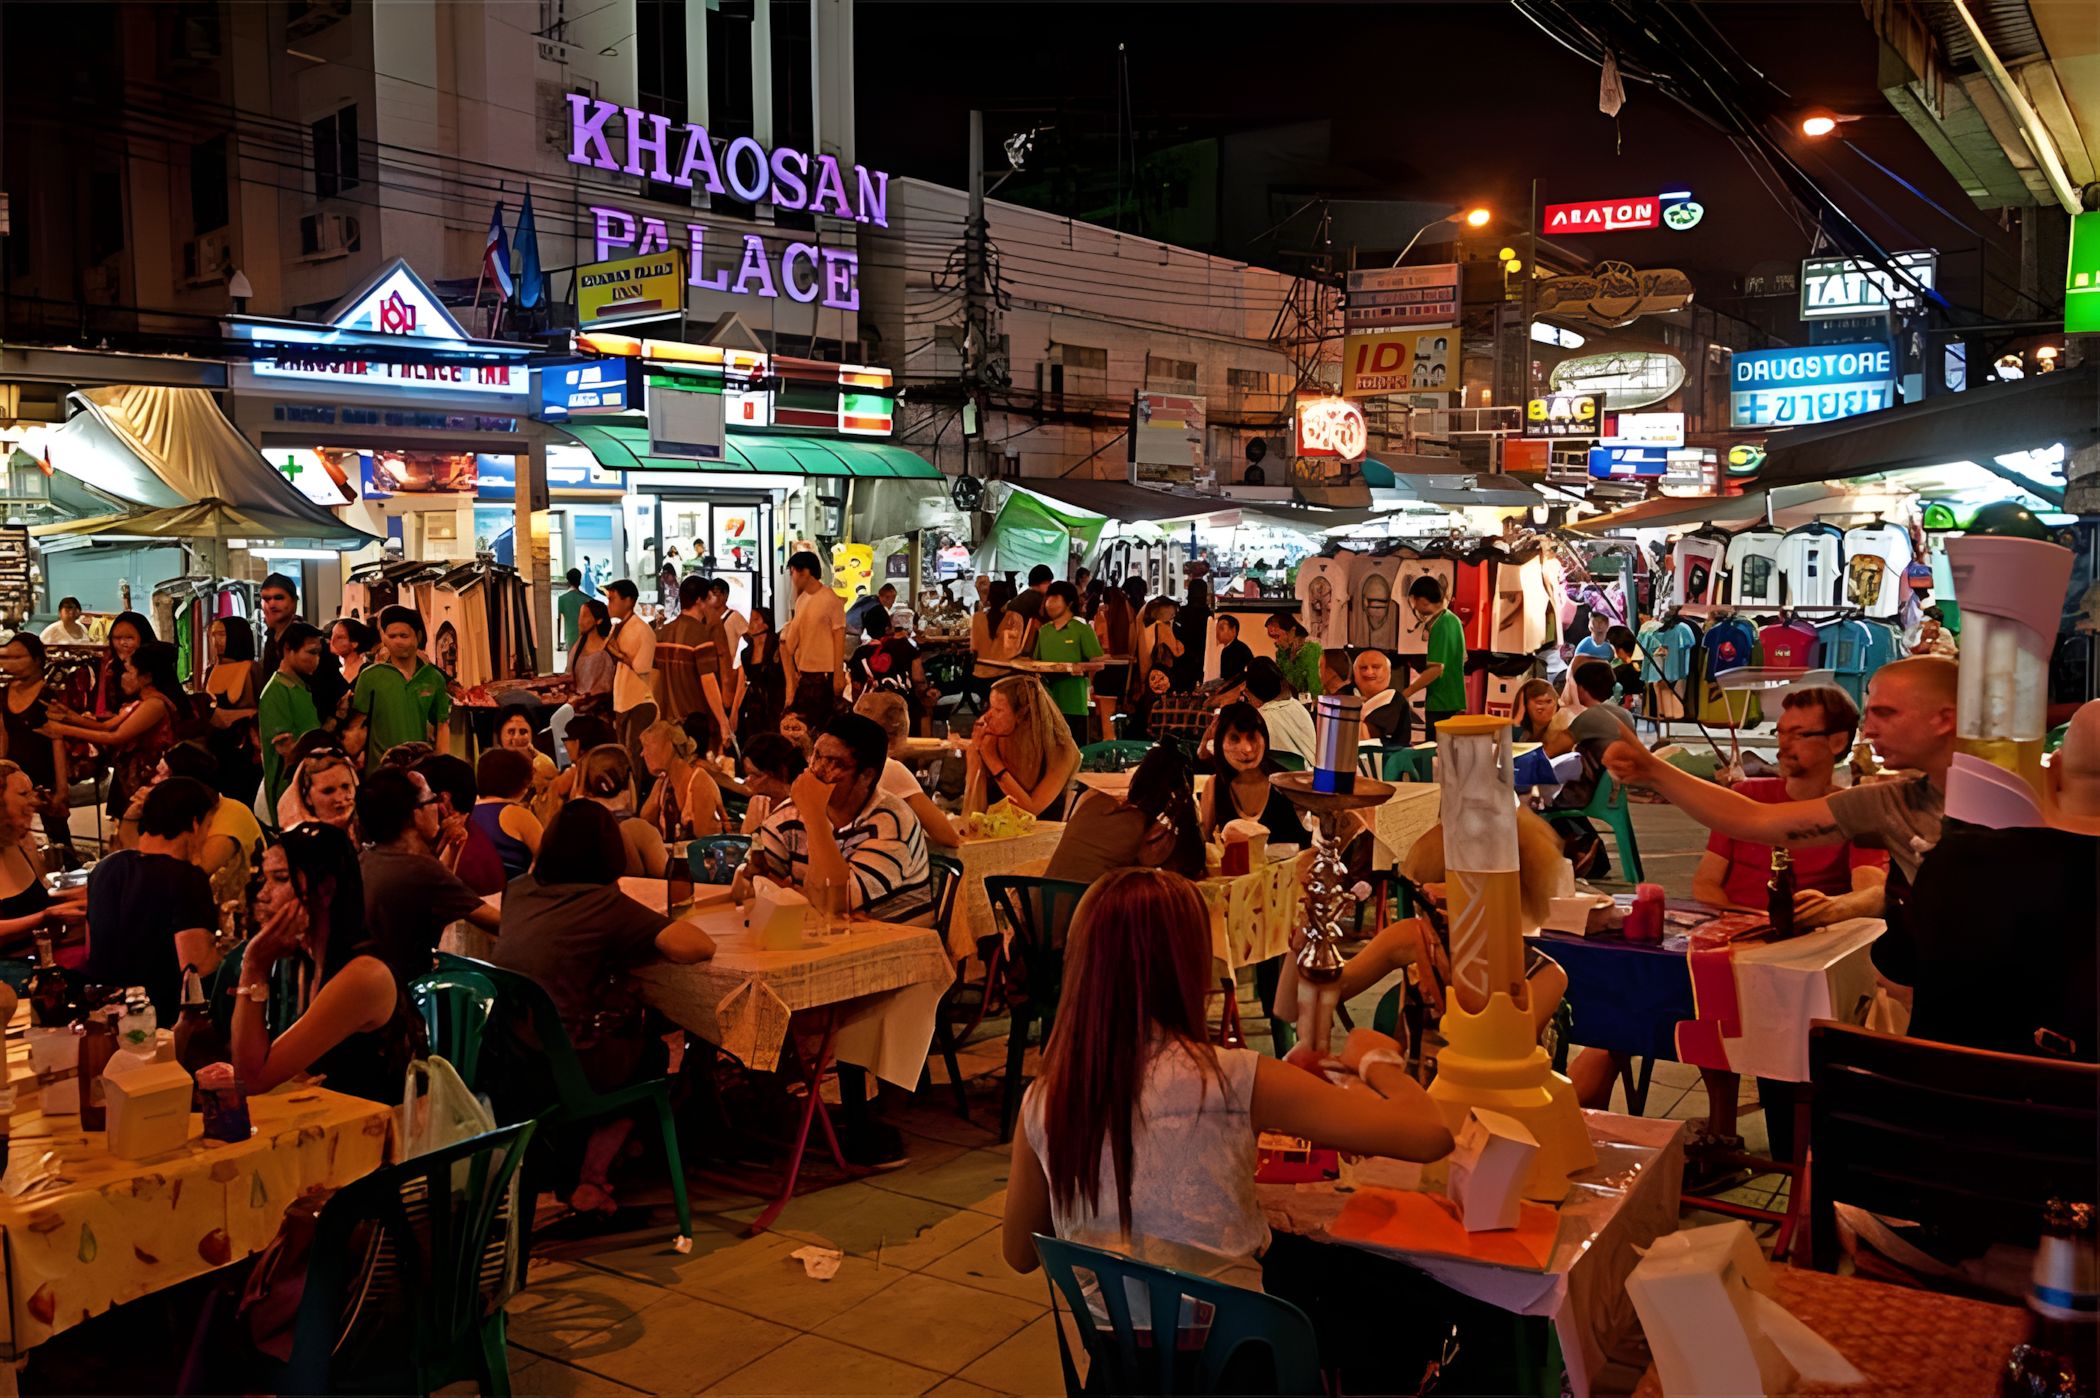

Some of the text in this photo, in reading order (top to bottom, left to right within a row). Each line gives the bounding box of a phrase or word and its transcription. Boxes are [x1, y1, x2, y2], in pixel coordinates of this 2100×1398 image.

[566, 93, 889, 229] KHAOSAN
[589, 206, 860, 311] PALACE
[1355, 342, 1406, 375] ID
[1737, 350, 1890, 382] DRUGSTORE
[1527, 396, 1596, 422] BAG
